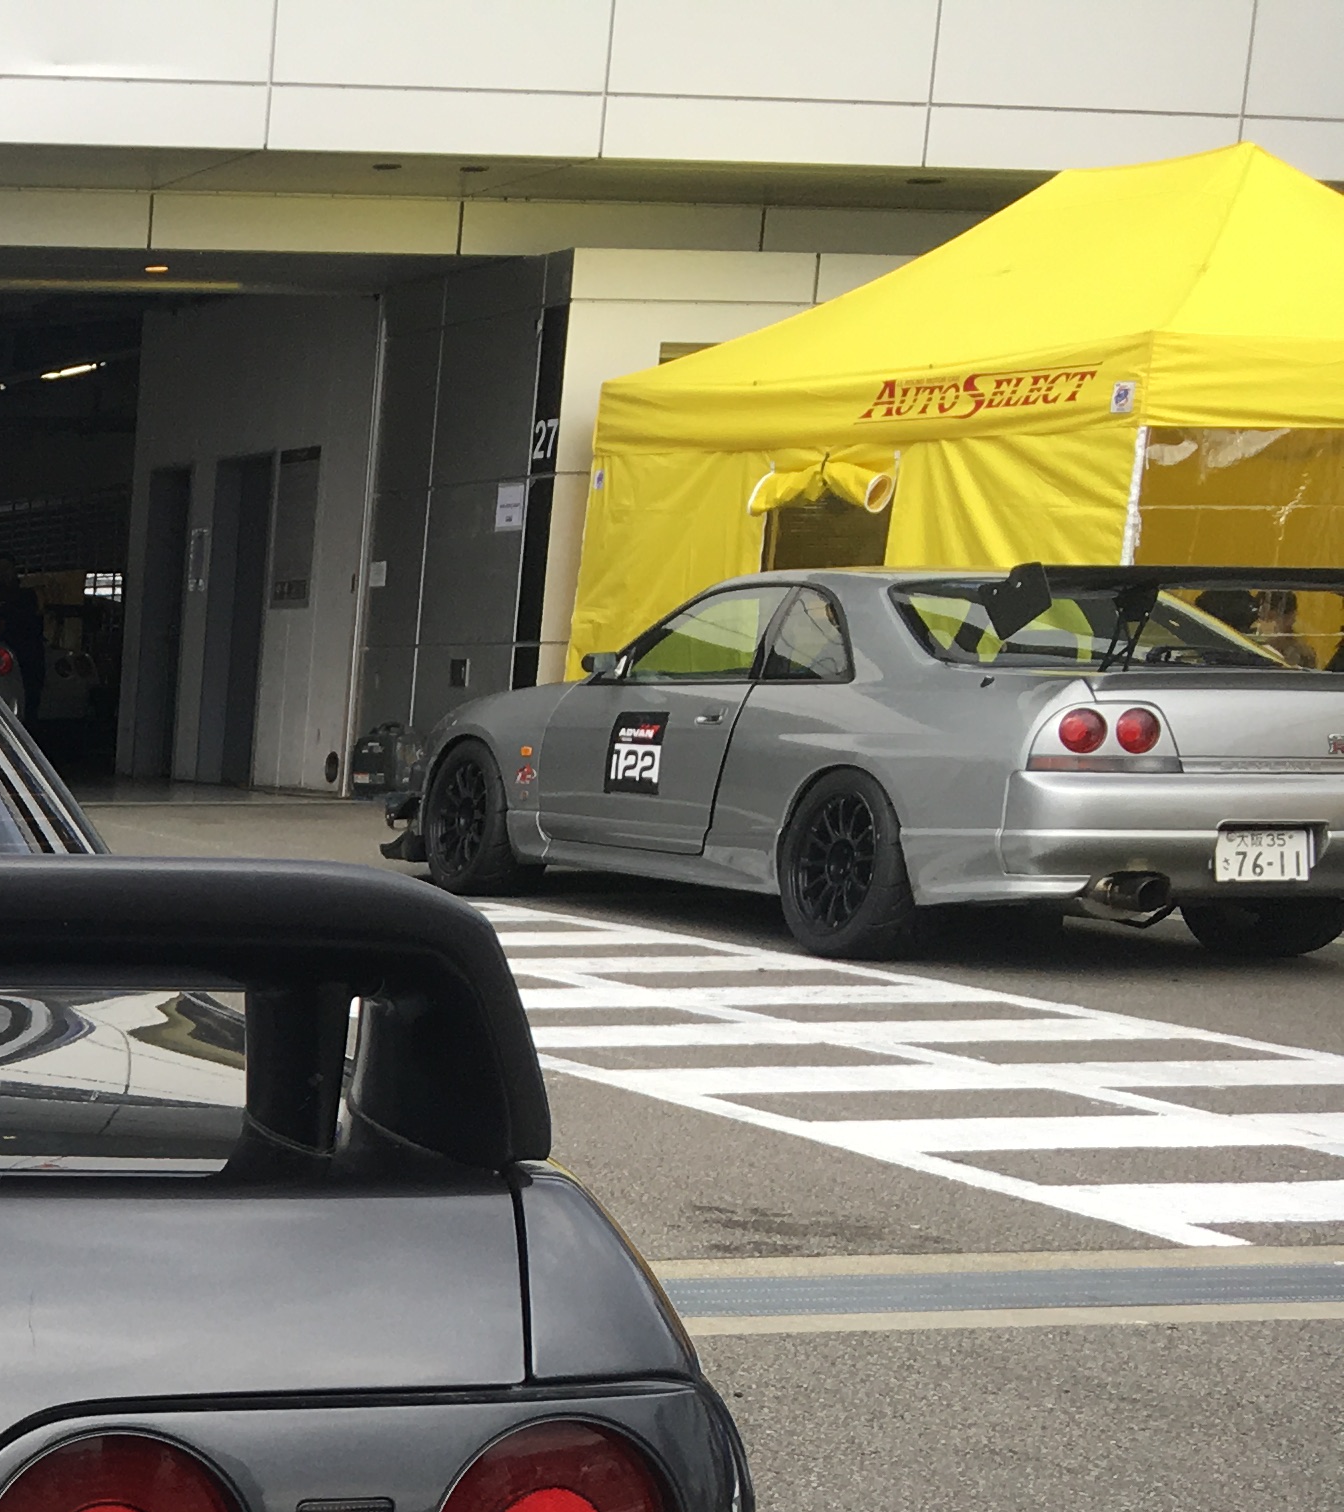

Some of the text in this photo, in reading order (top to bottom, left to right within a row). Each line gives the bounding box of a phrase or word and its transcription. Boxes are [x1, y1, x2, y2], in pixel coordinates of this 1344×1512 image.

[532, 418, 559, 460] 27
[618, 727, 655, 739] ADVAN
[614, 749, 656, 780] 122
[1266, 833, 1286, 848] 35
[1235, 850, 1301, 877] 76-11
